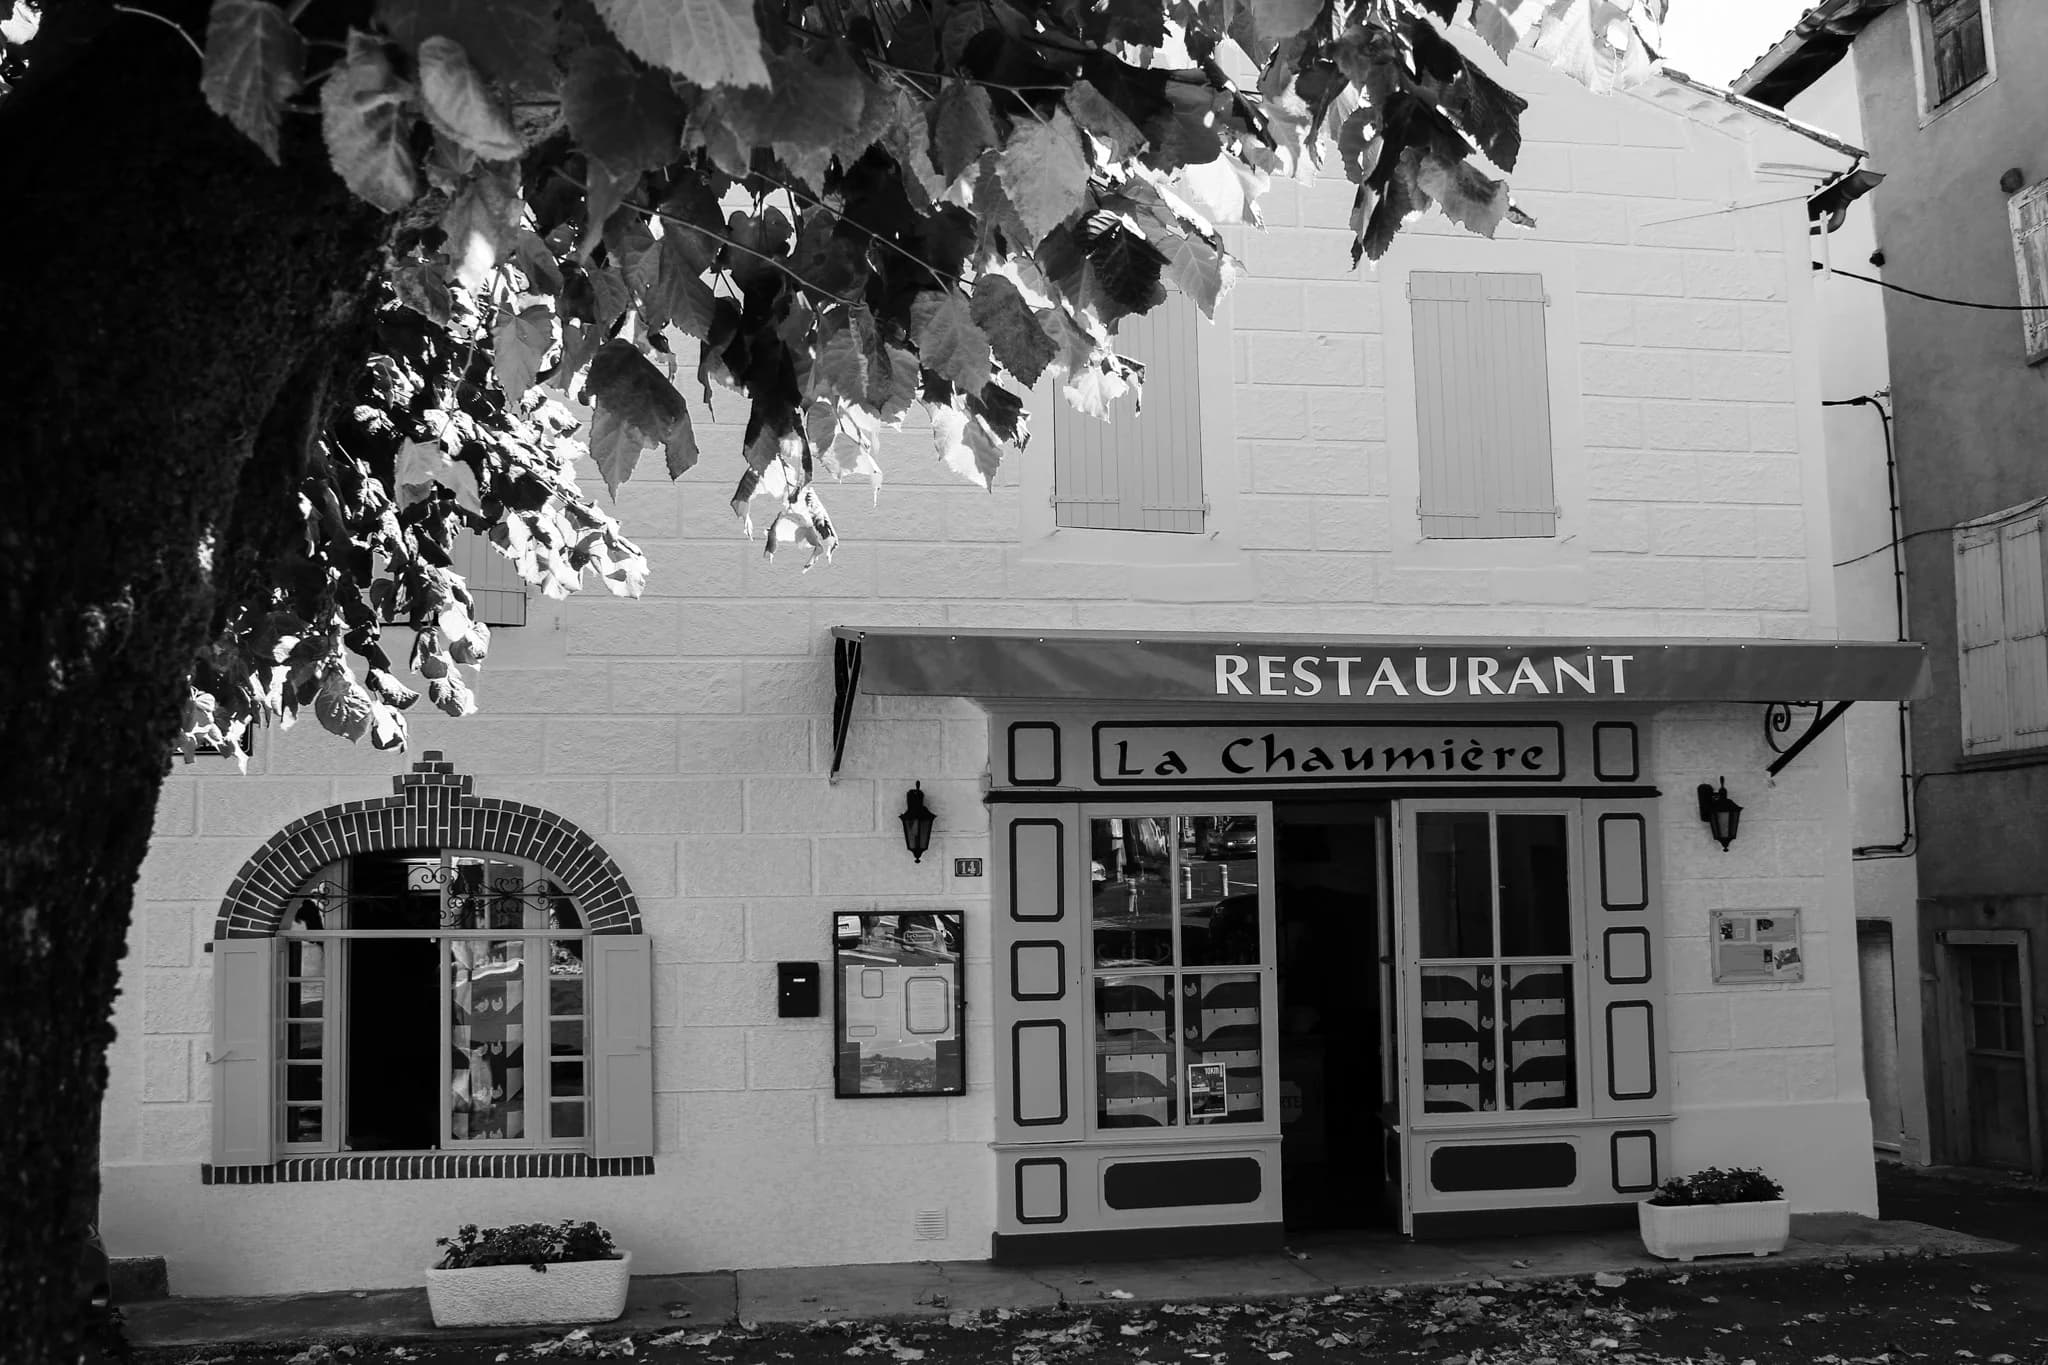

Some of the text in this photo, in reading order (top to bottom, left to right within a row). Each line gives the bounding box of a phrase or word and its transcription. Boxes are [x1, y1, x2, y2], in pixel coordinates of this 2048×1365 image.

[1215, 654, 1634, 697] RESTAURANT
[1115, 733, 1545, 777] La Chaumière
[961, 861, 976, 874] 14
